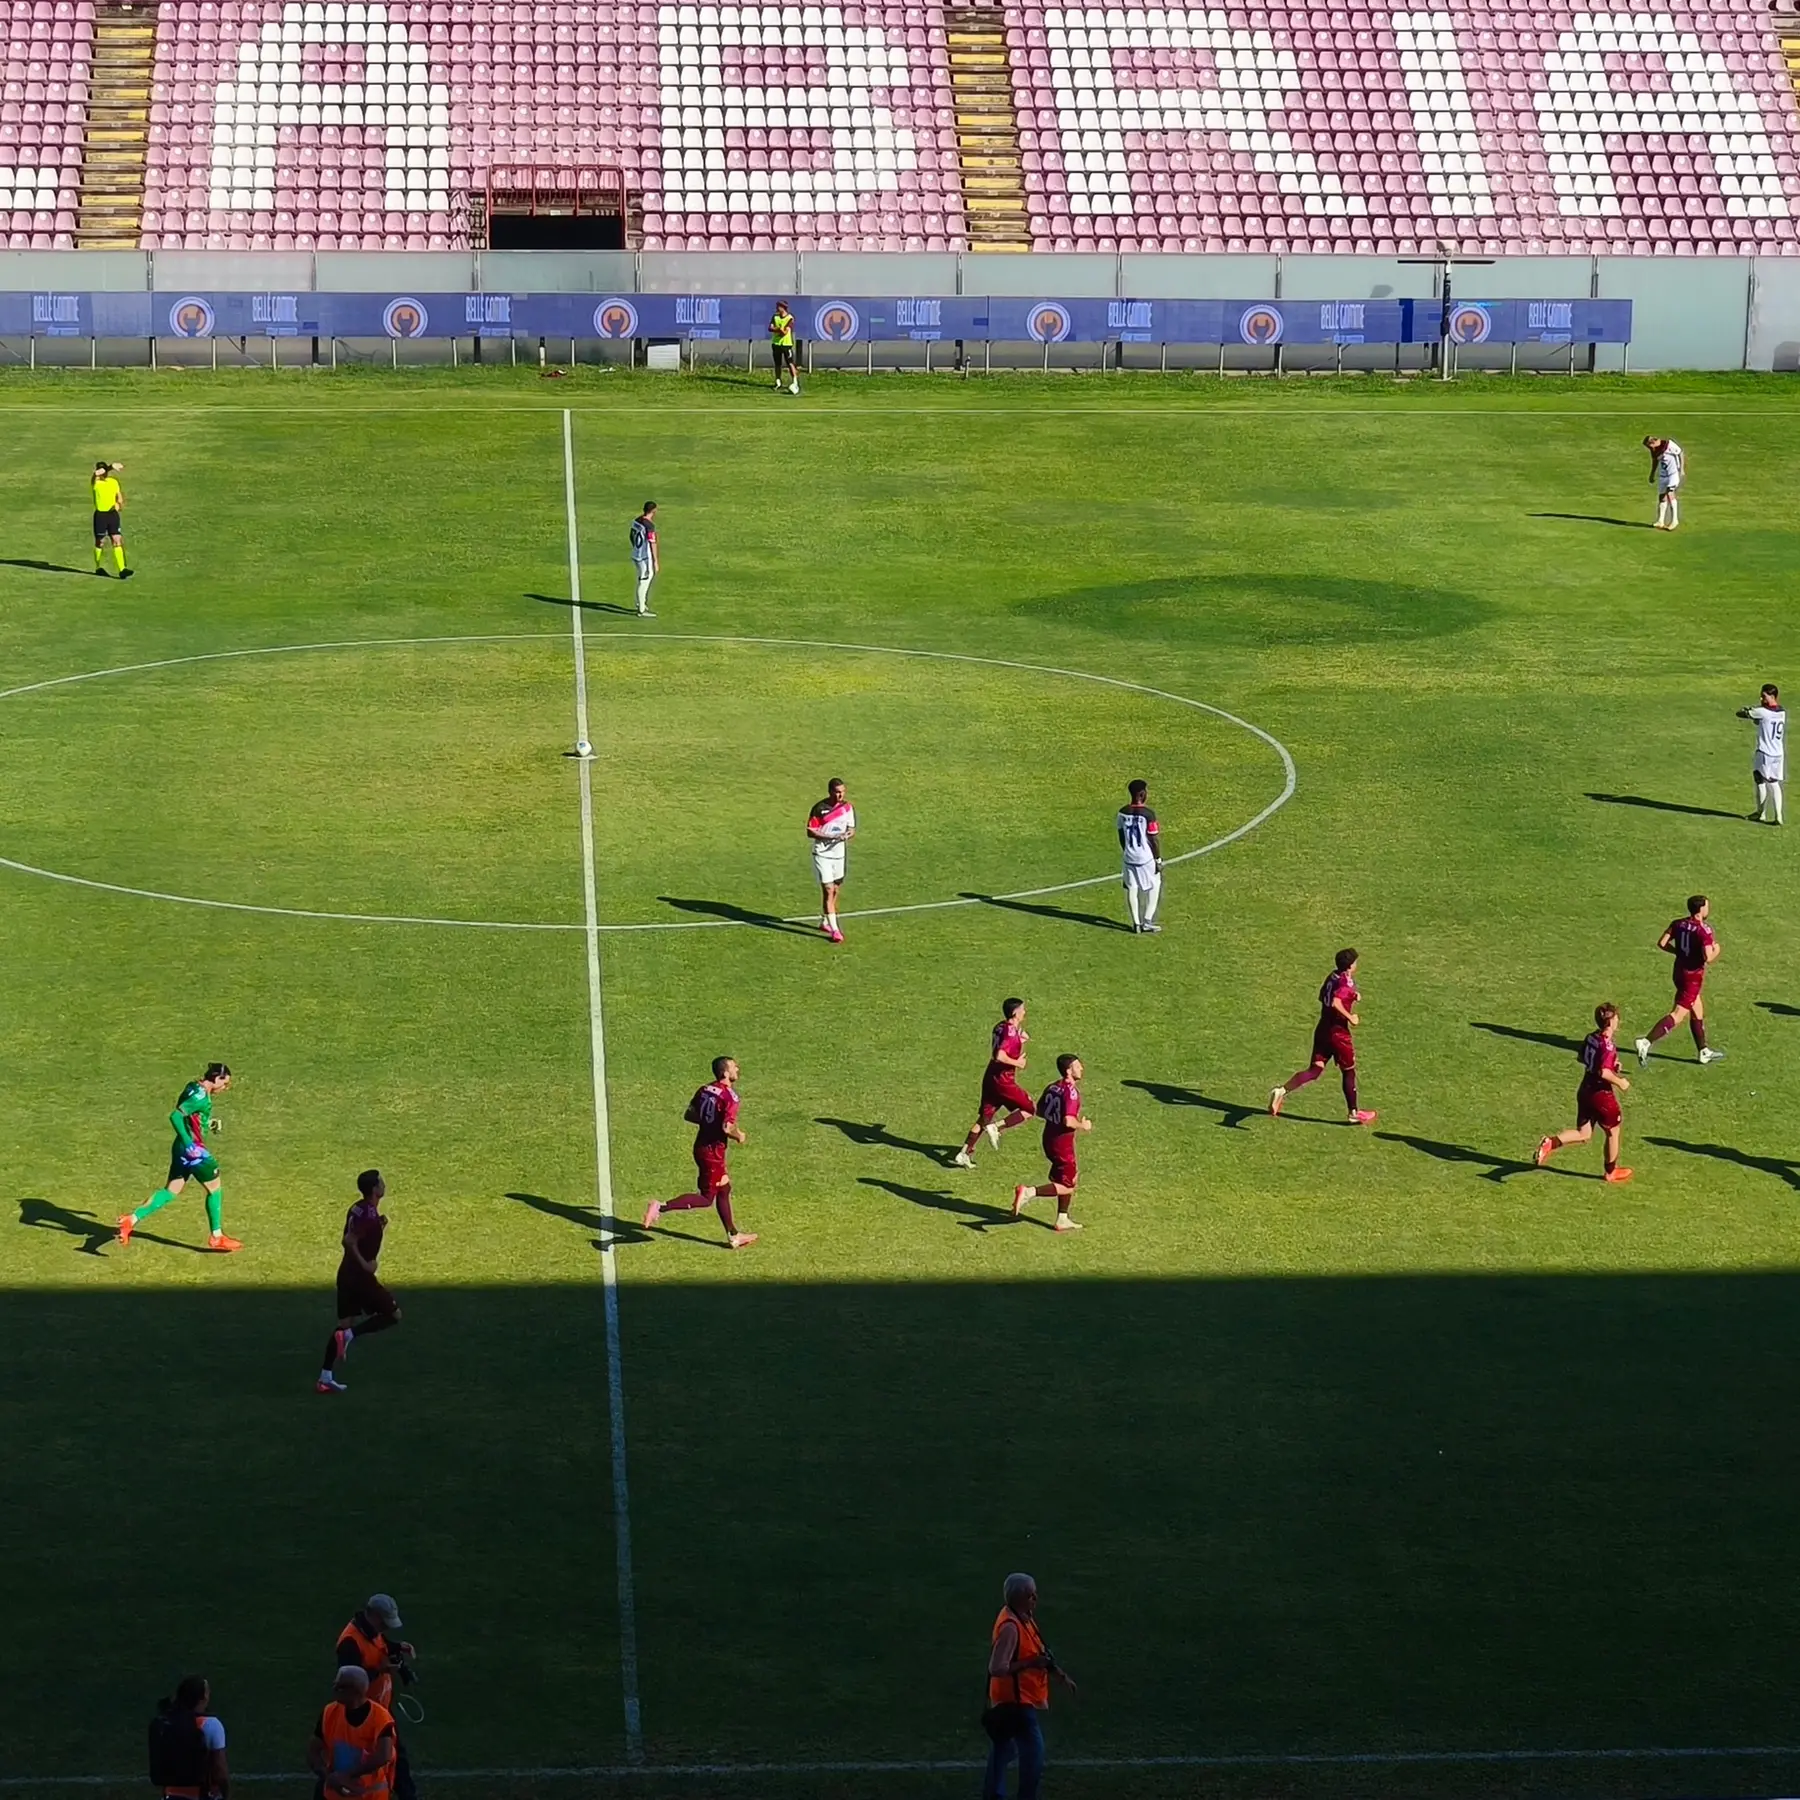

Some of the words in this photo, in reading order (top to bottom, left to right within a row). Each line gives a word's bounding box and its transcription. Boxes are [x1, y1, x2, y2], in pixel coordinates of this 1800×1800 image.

[1770, 721, 1784, 740] 19
[1680, 931, 1691, 957] 4
[1044, 1093, 1061, 1124] 23
